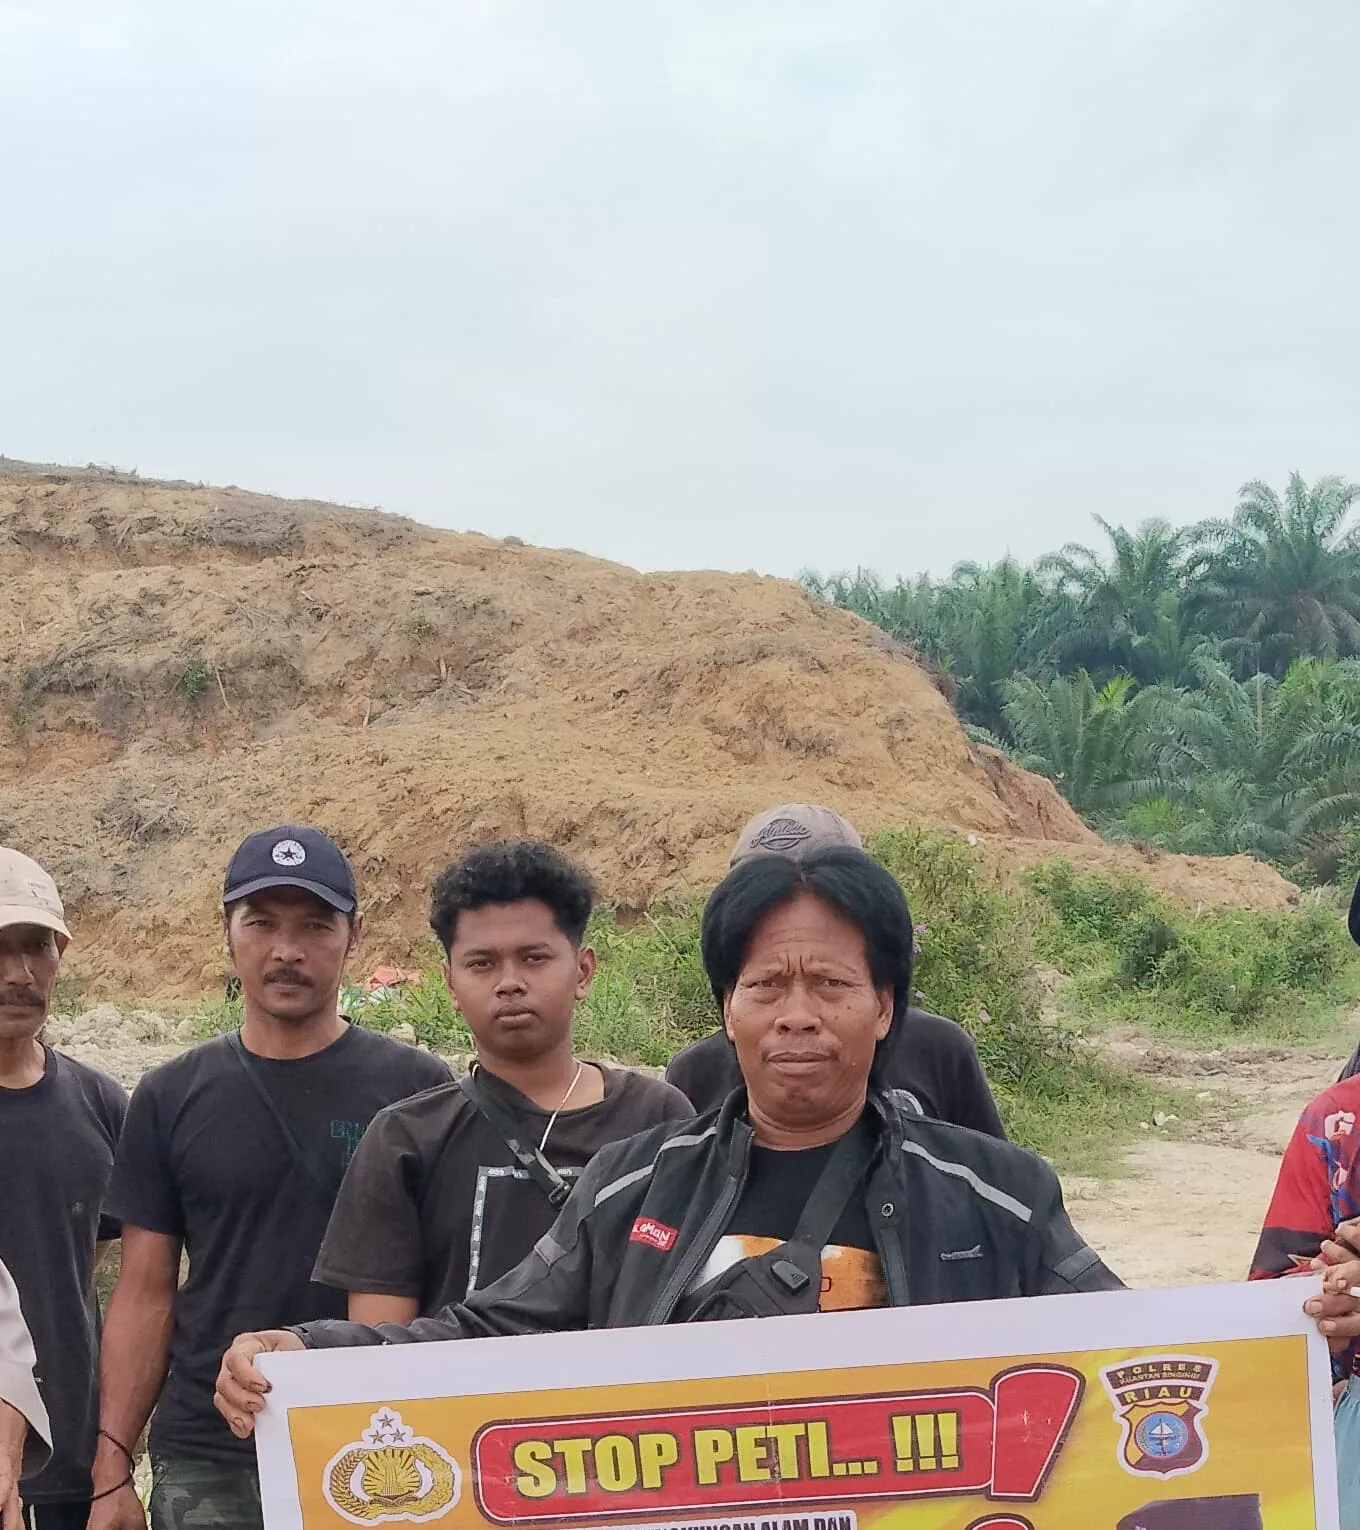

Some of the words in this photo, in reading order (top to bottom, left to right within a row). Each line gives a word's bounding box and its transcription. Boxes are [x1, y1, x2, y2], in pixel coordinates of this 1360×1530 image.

[1124, 1386, 1193, 1403] RIAU
[513, 1432, 679, 1498] STOP
[890, 1411, 960, 1473] !!!
